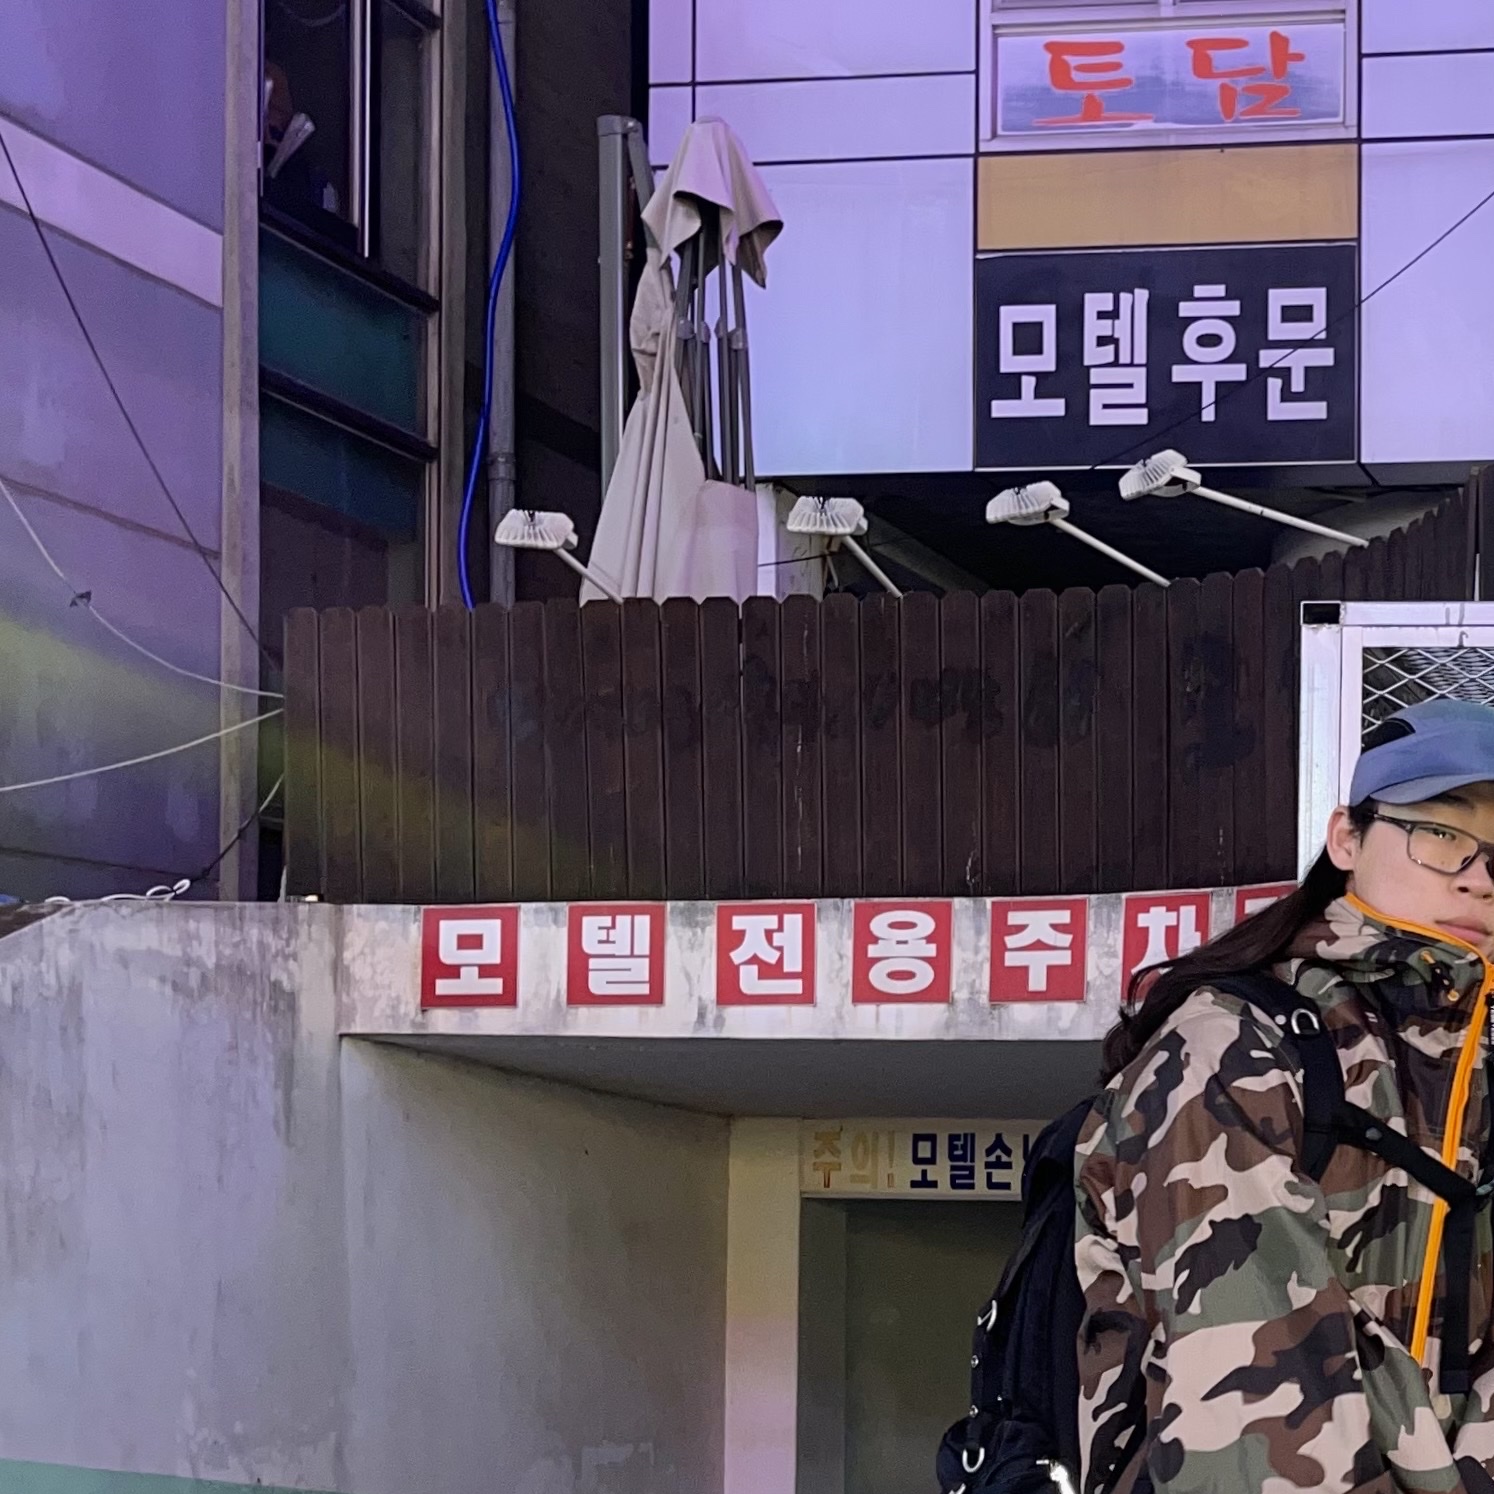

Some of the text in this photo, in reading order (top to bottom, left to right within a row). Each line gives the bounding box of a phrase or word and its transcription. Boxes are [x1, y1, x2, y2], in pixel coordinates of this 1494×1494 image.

[990, 284, 1335, 426] 모텔후문
[435, 896, 1283, 996] 모텔전용주차
[910, 1132, 1030, 1191] 모텔손
